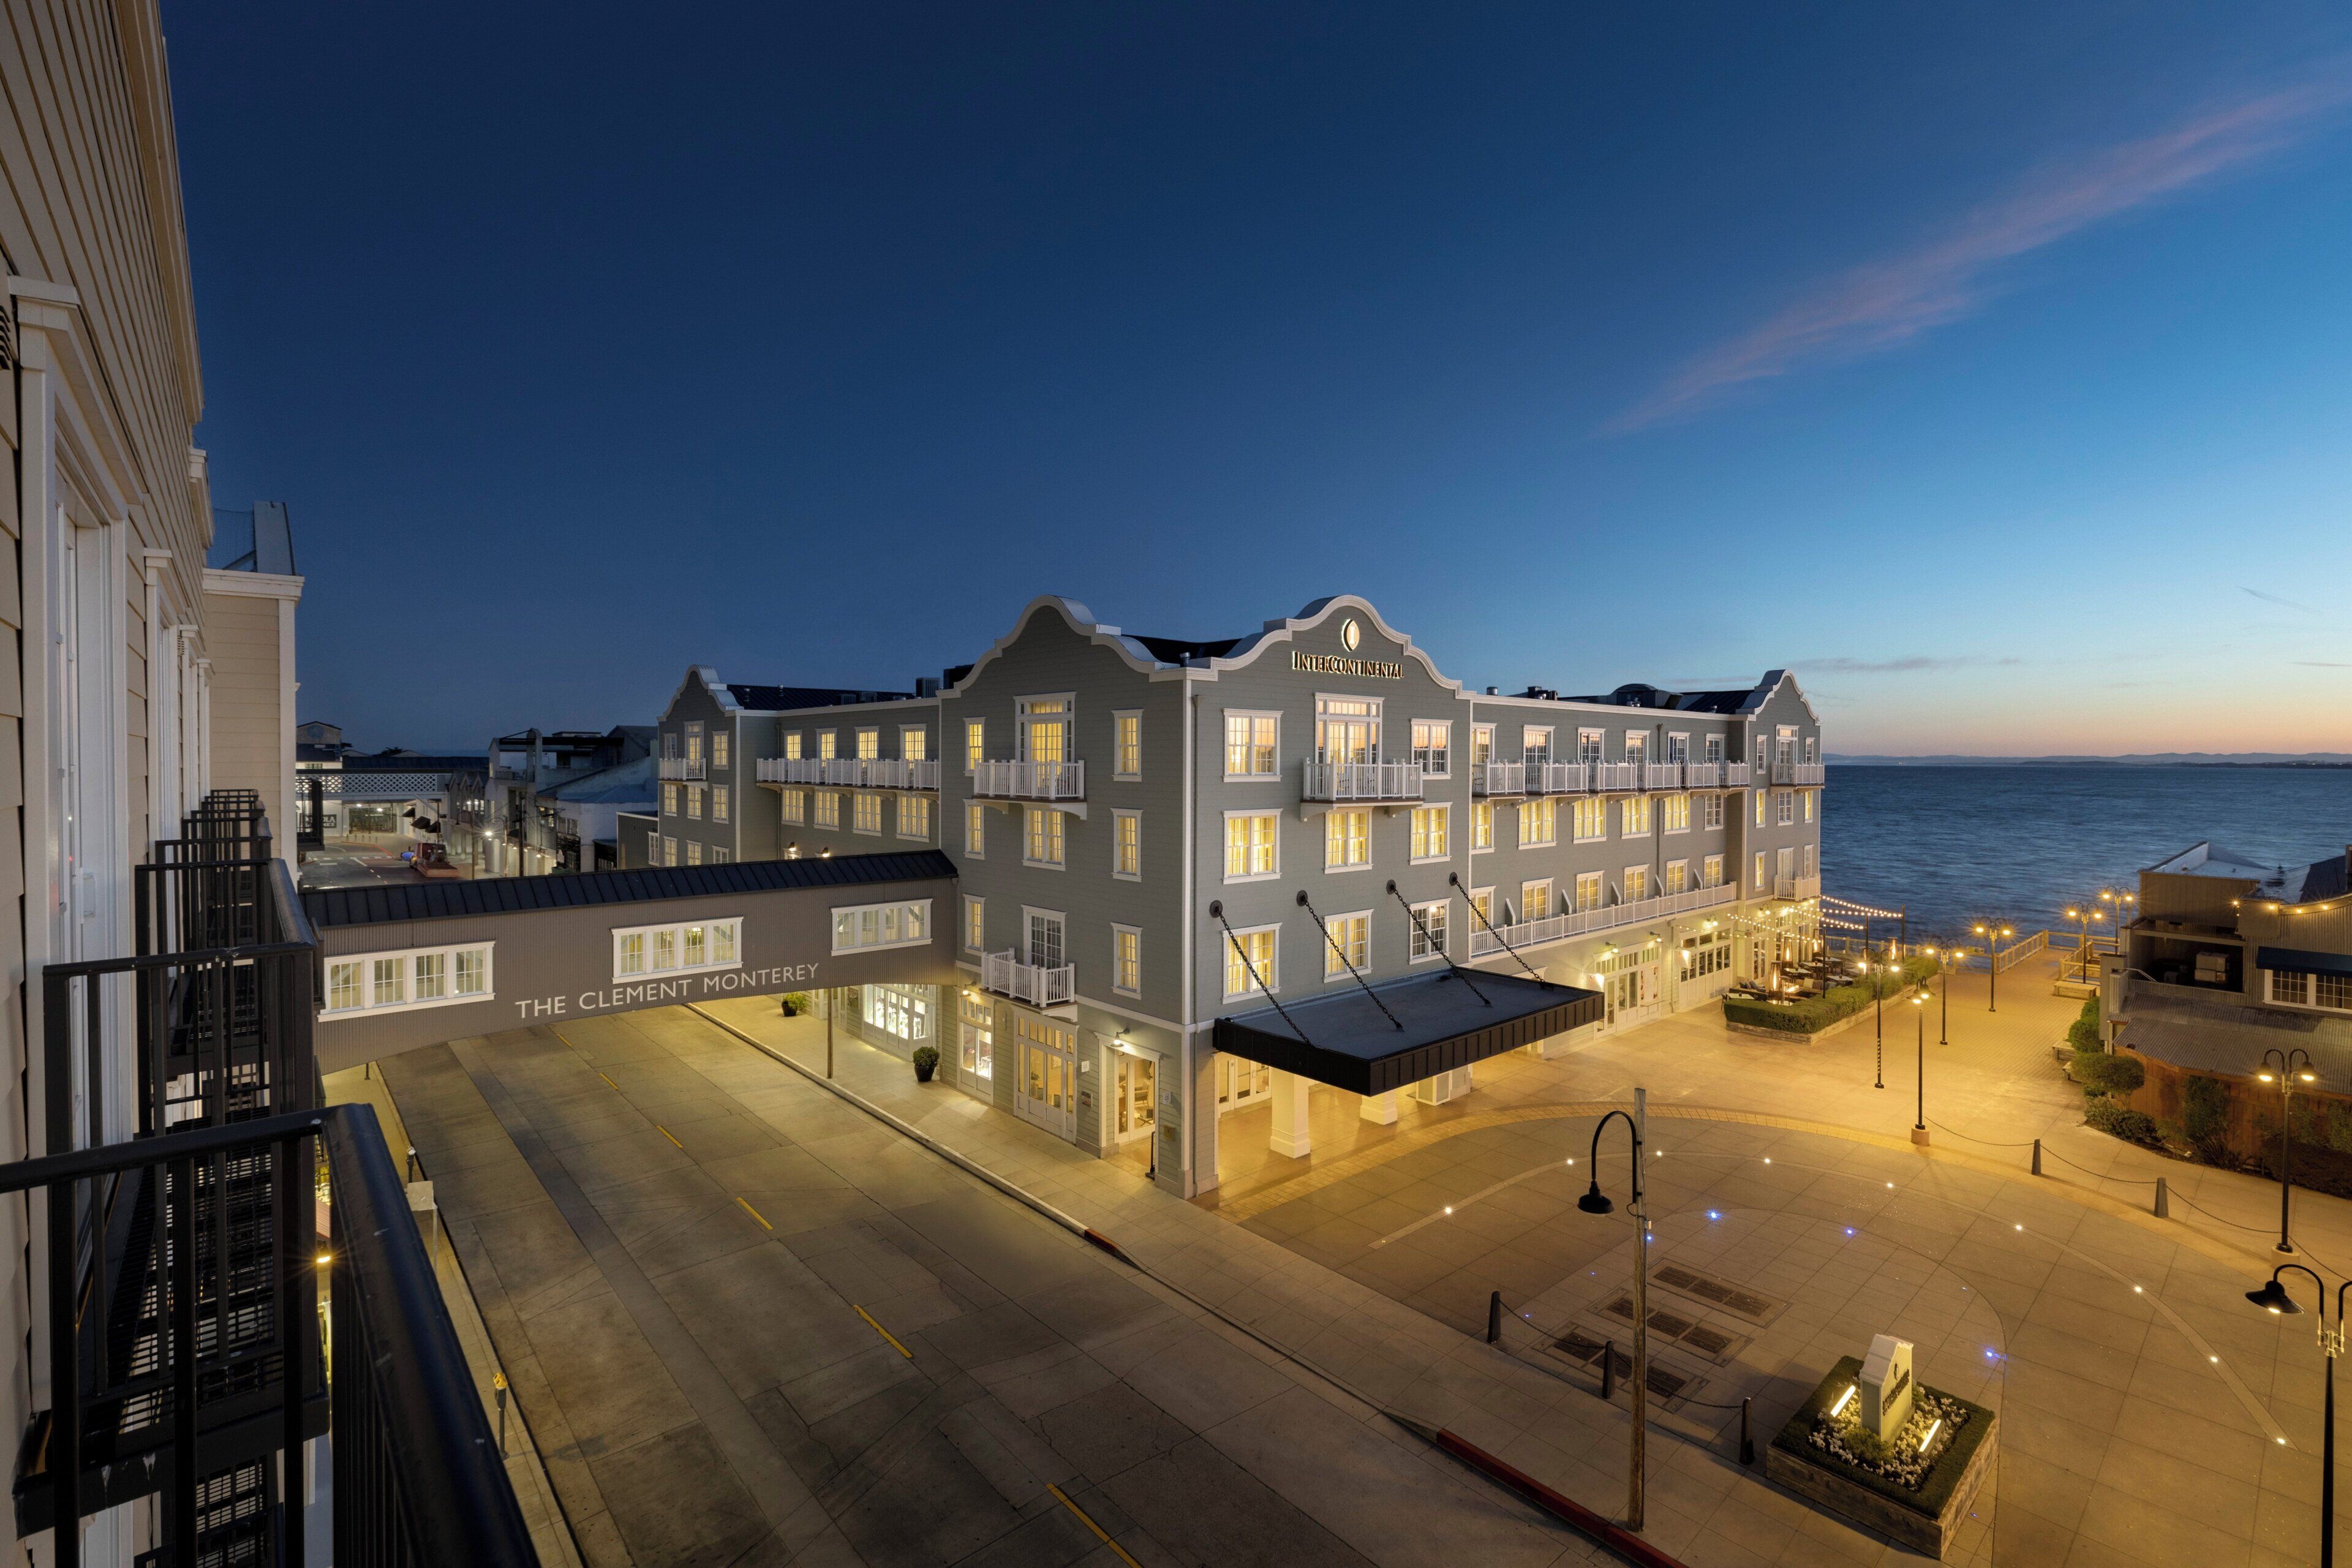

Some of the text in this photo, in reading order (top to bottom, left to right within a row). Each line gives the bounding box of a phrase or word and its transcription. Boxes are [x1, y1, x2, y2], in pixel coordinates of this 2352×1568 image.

[1292, 650, 1404, 679] INTERCONTINENTAL
[515, 963, 819, 1019] THE CLEMENT MONTEREY
